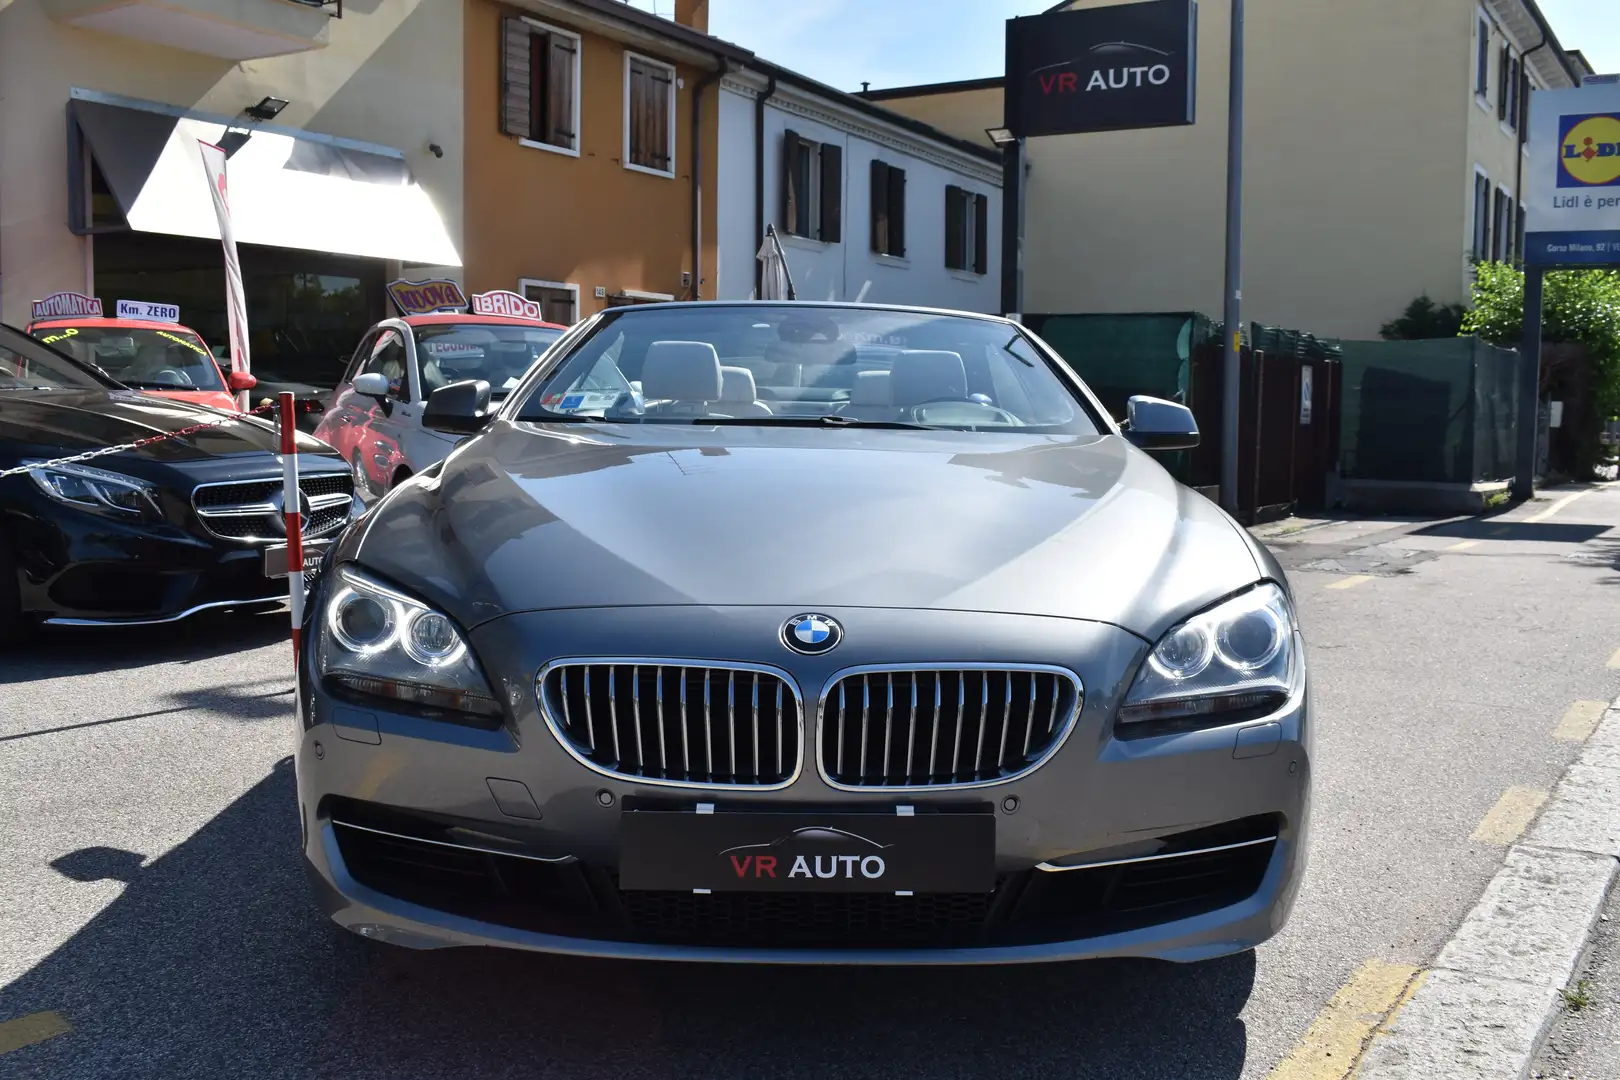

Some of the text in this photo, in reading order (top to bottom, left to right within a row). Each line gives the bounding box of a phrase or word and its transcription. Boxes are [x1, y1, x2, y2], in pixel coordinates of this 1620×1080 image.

[1039, 63, 1170, 96] VR AUTO
[1553, 195, 1579, 208] Lidl
[1584, 194, 1592, 208] è
[35, 293, 100, 316] AUTOMATICA
[395, 284, 461, 309] NUOVA
[475, 294, 538, 317] IBRIDO
[120, 303, 176, 319] Km. ZERO
[156, 331, 207, 356] AUTOMATICA
[730, 855, 886, 879] VR AUTO
